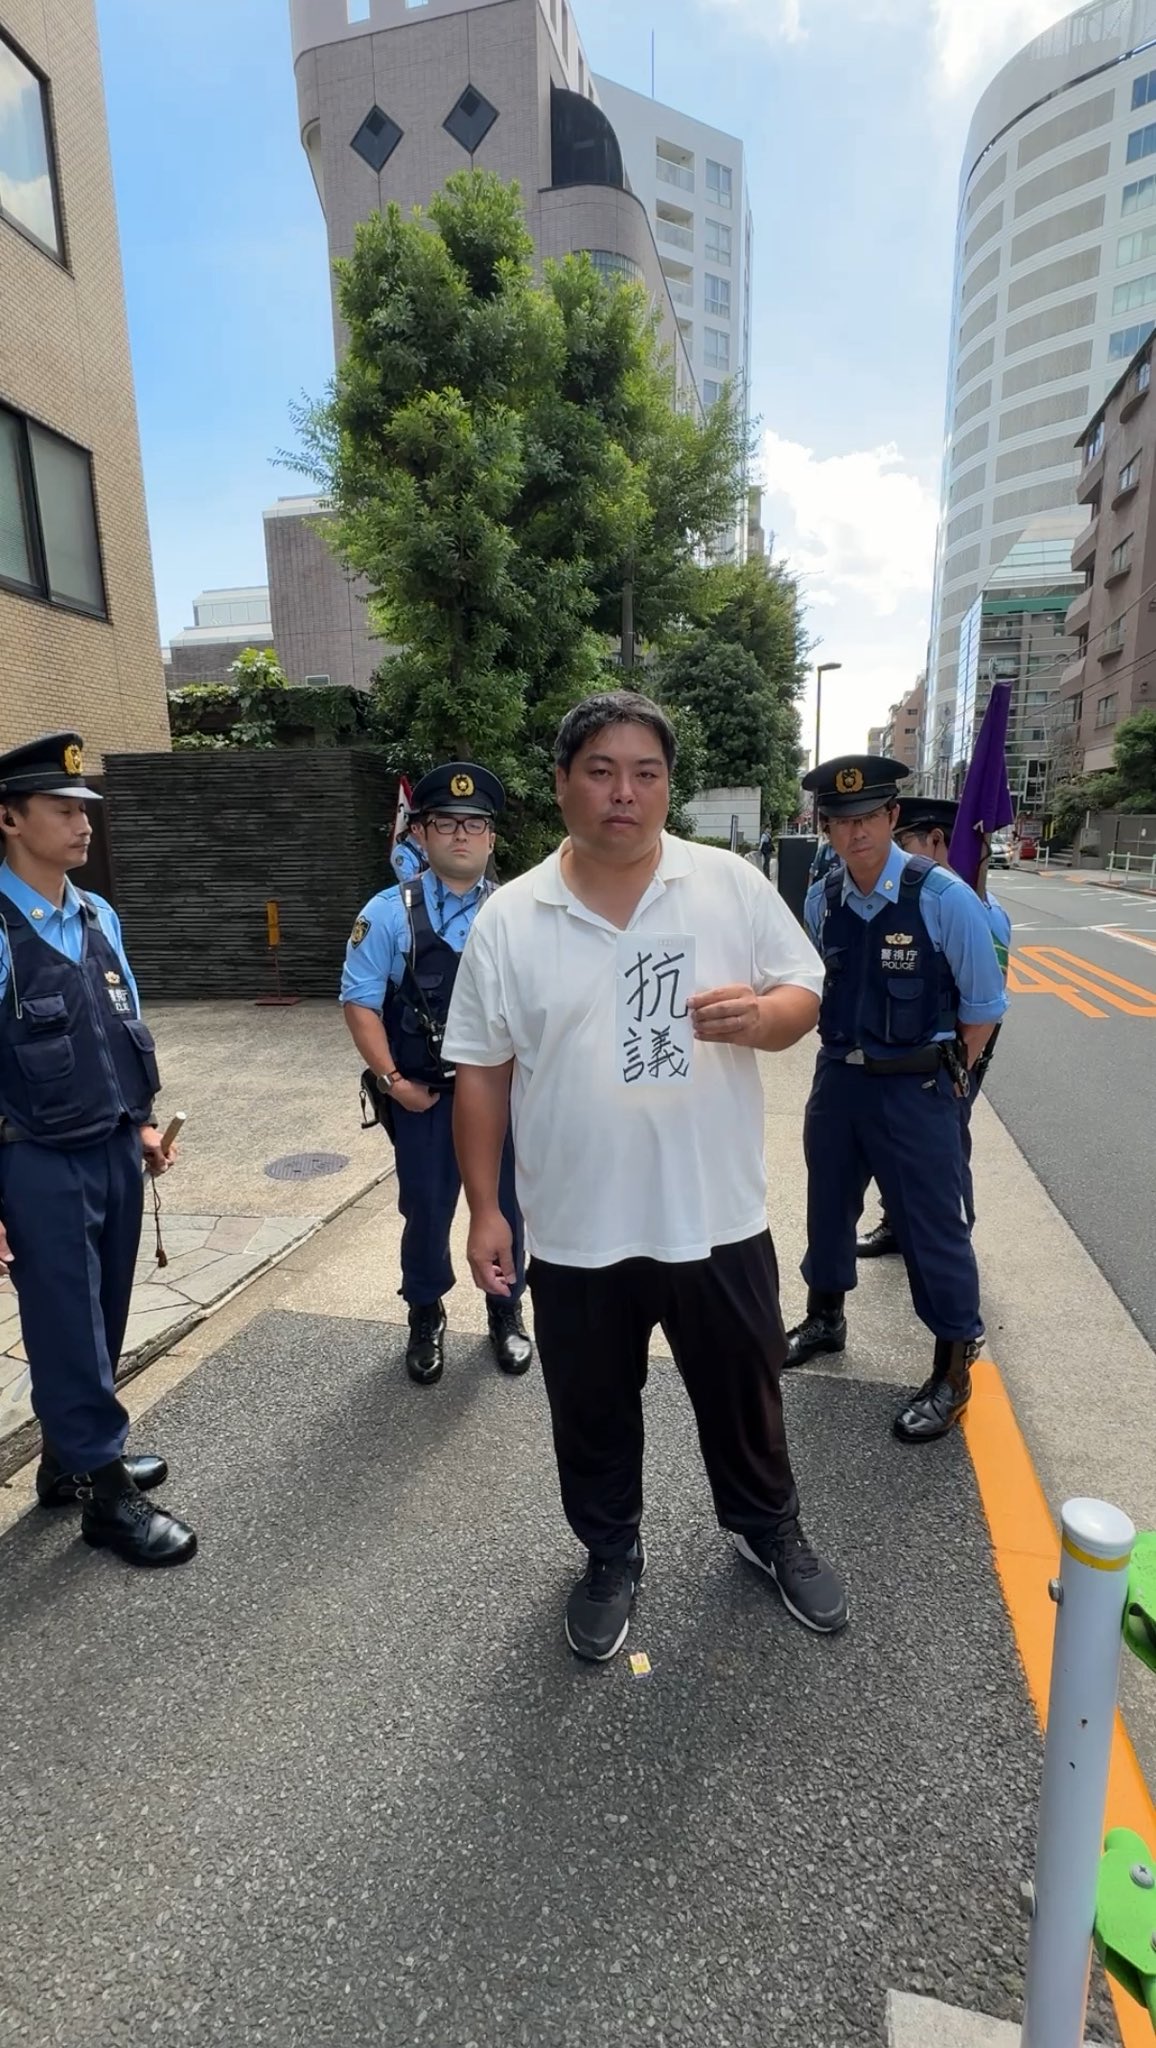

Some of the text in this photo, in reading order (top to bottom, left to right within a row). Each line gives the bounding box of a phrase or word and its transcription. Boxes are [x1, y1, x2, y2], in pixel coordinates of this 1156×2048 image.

[881, 948, 918, 961] 警視庁
[881, 960, 916, 970] POLICE
[623, 951, 690, 1083] 抗議
